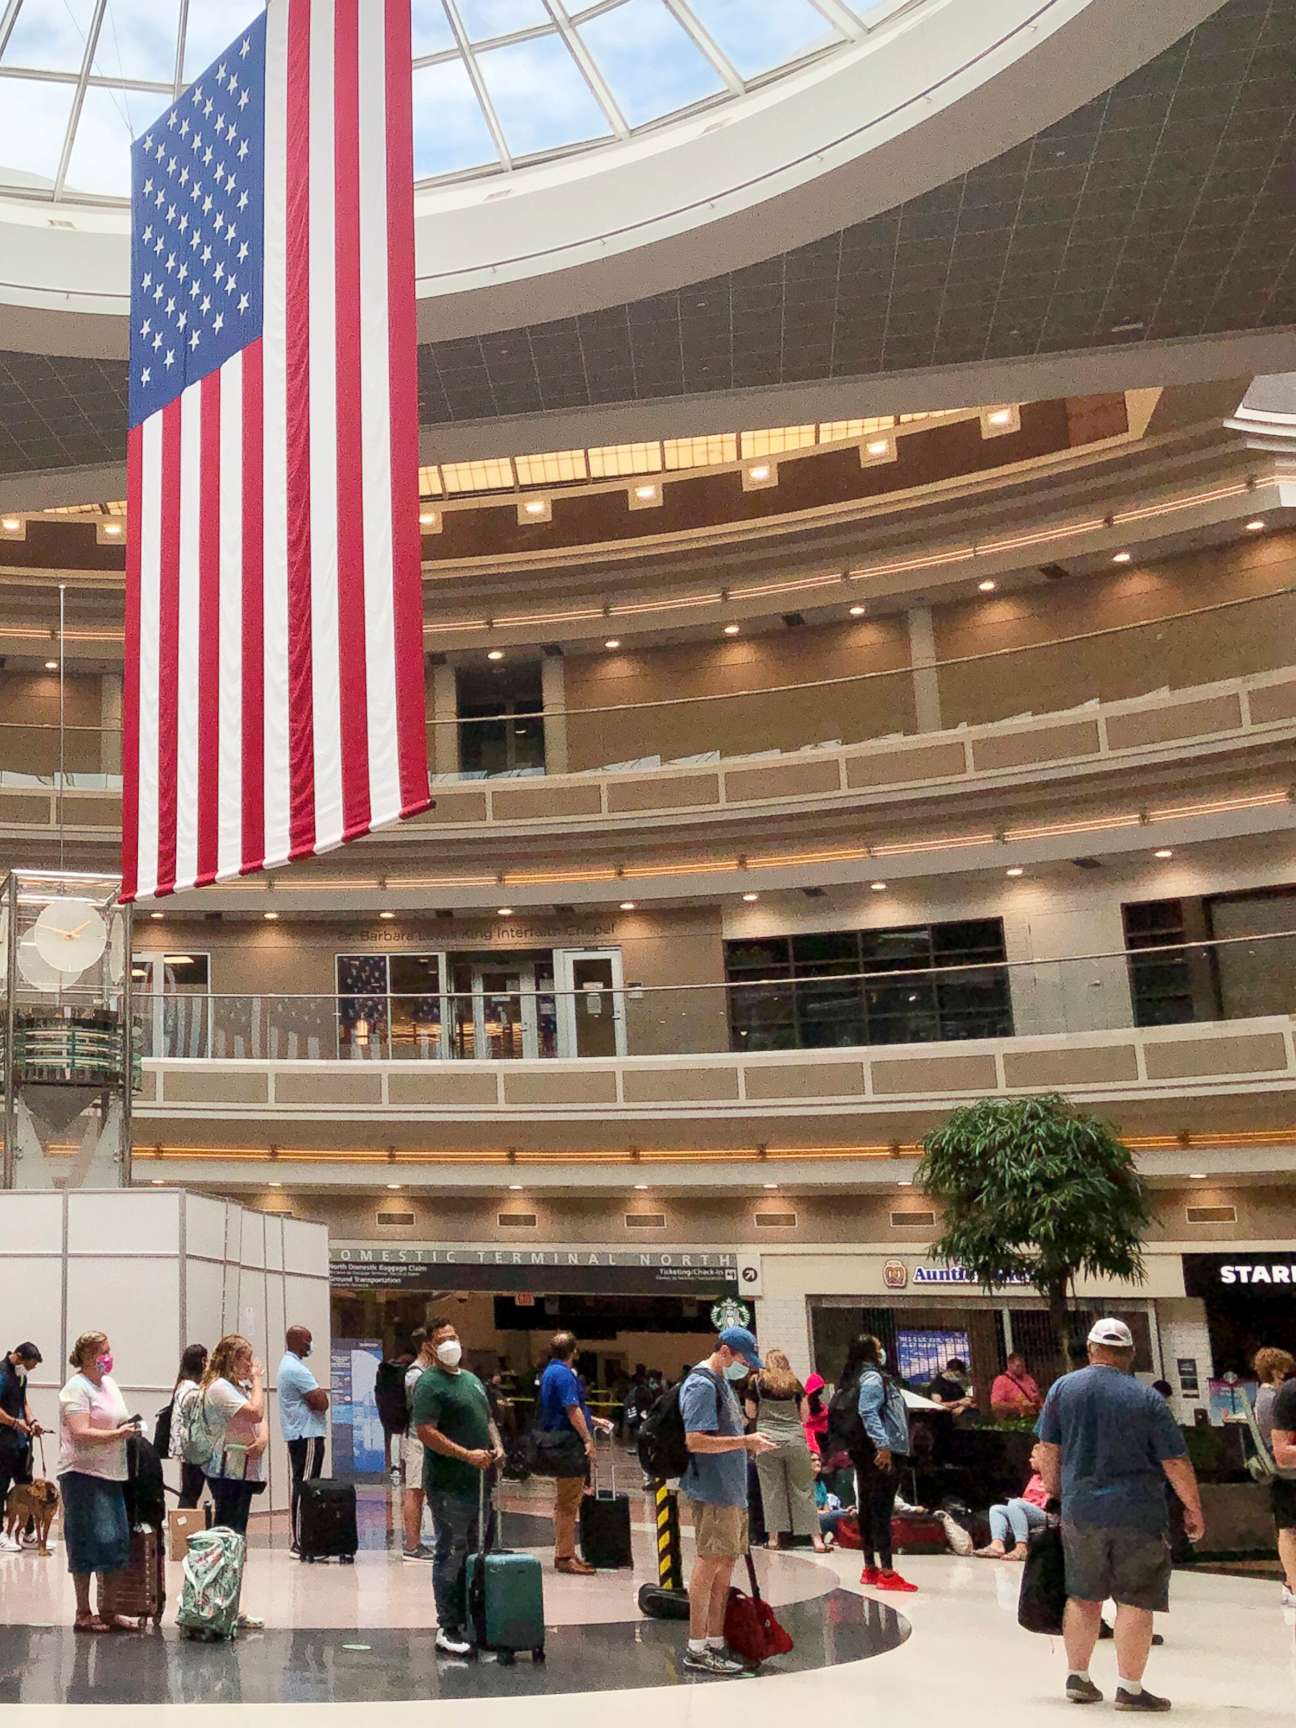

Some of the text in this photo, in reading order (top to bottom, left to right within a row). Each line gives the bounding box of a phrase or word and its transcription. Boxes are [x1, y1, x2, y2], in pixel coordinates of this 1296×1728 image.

[360, 930, 414, 942] Barbara
[477, 1251, 617, 1265] TERMINAL
[639, 1253, 731, 1267] NORTH
